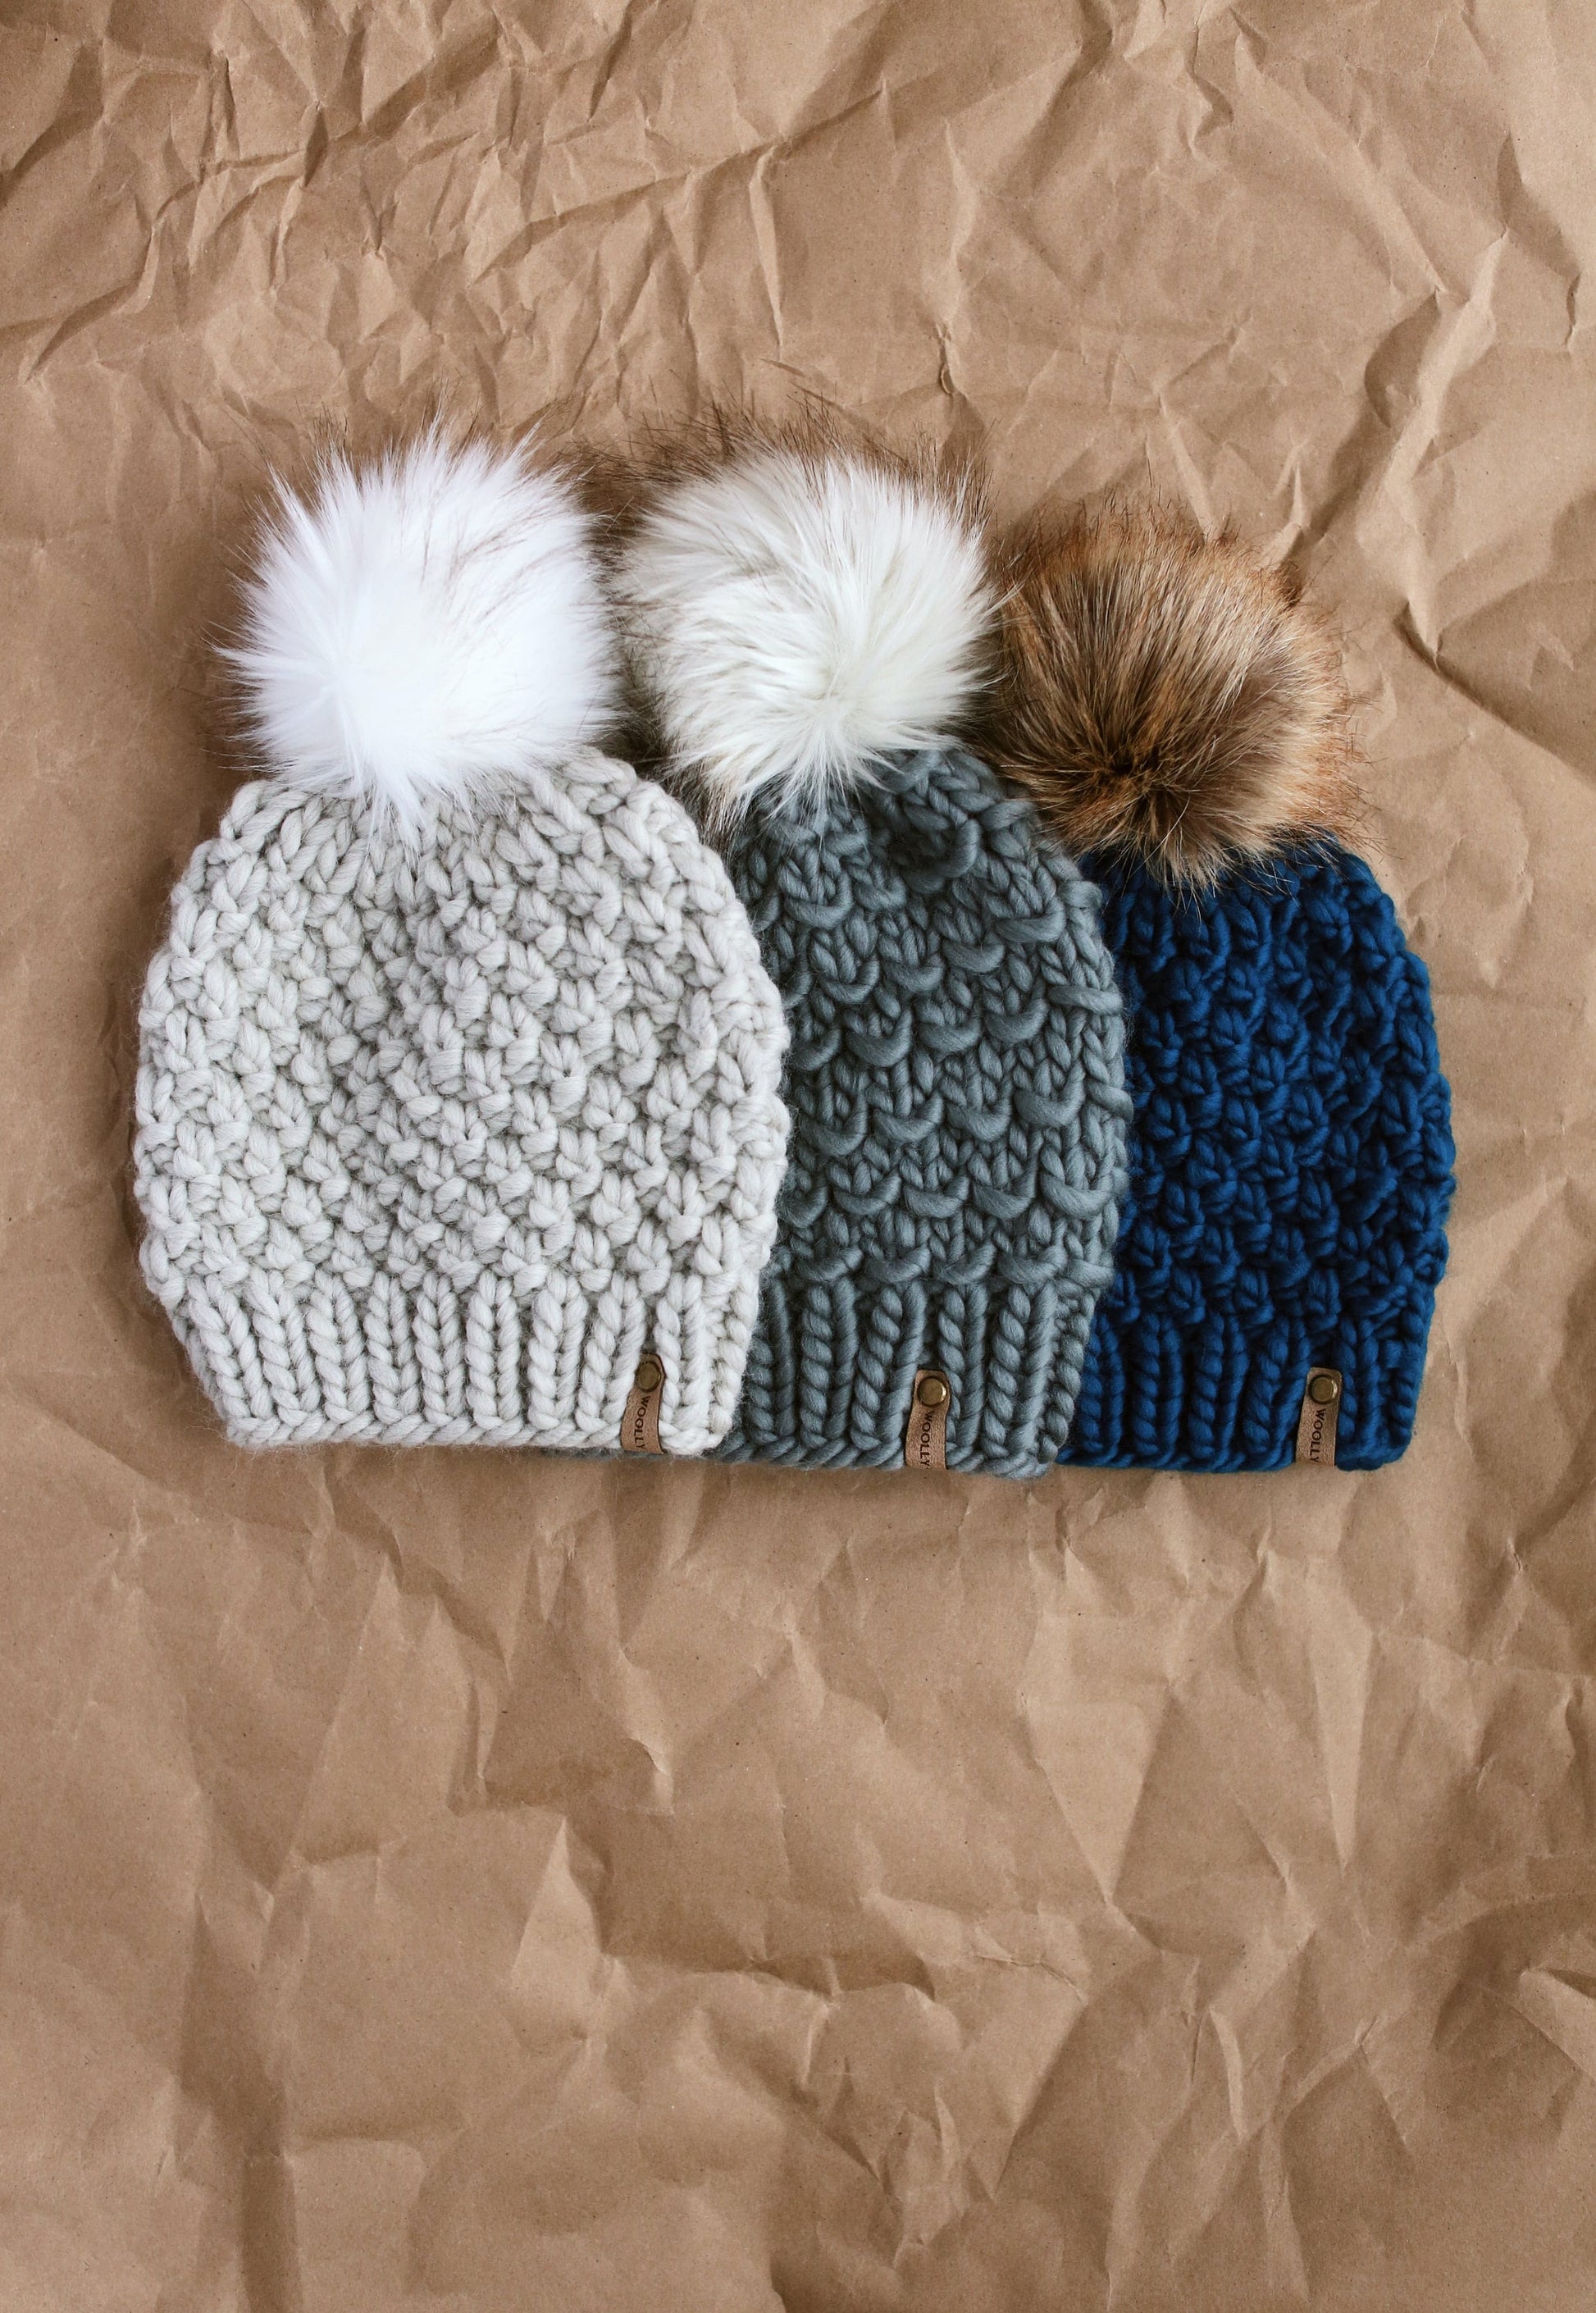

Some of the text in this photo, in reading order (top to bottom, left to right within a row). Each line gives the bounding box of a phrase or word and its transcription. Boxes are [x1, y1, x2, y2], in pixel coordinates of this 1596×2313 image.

[634, 1395, 650, 1449] WOOLLY
[920, 1411, 935, 1467] WOOLLY
[1310, 1408, 1326, 1463] WOOLLY
